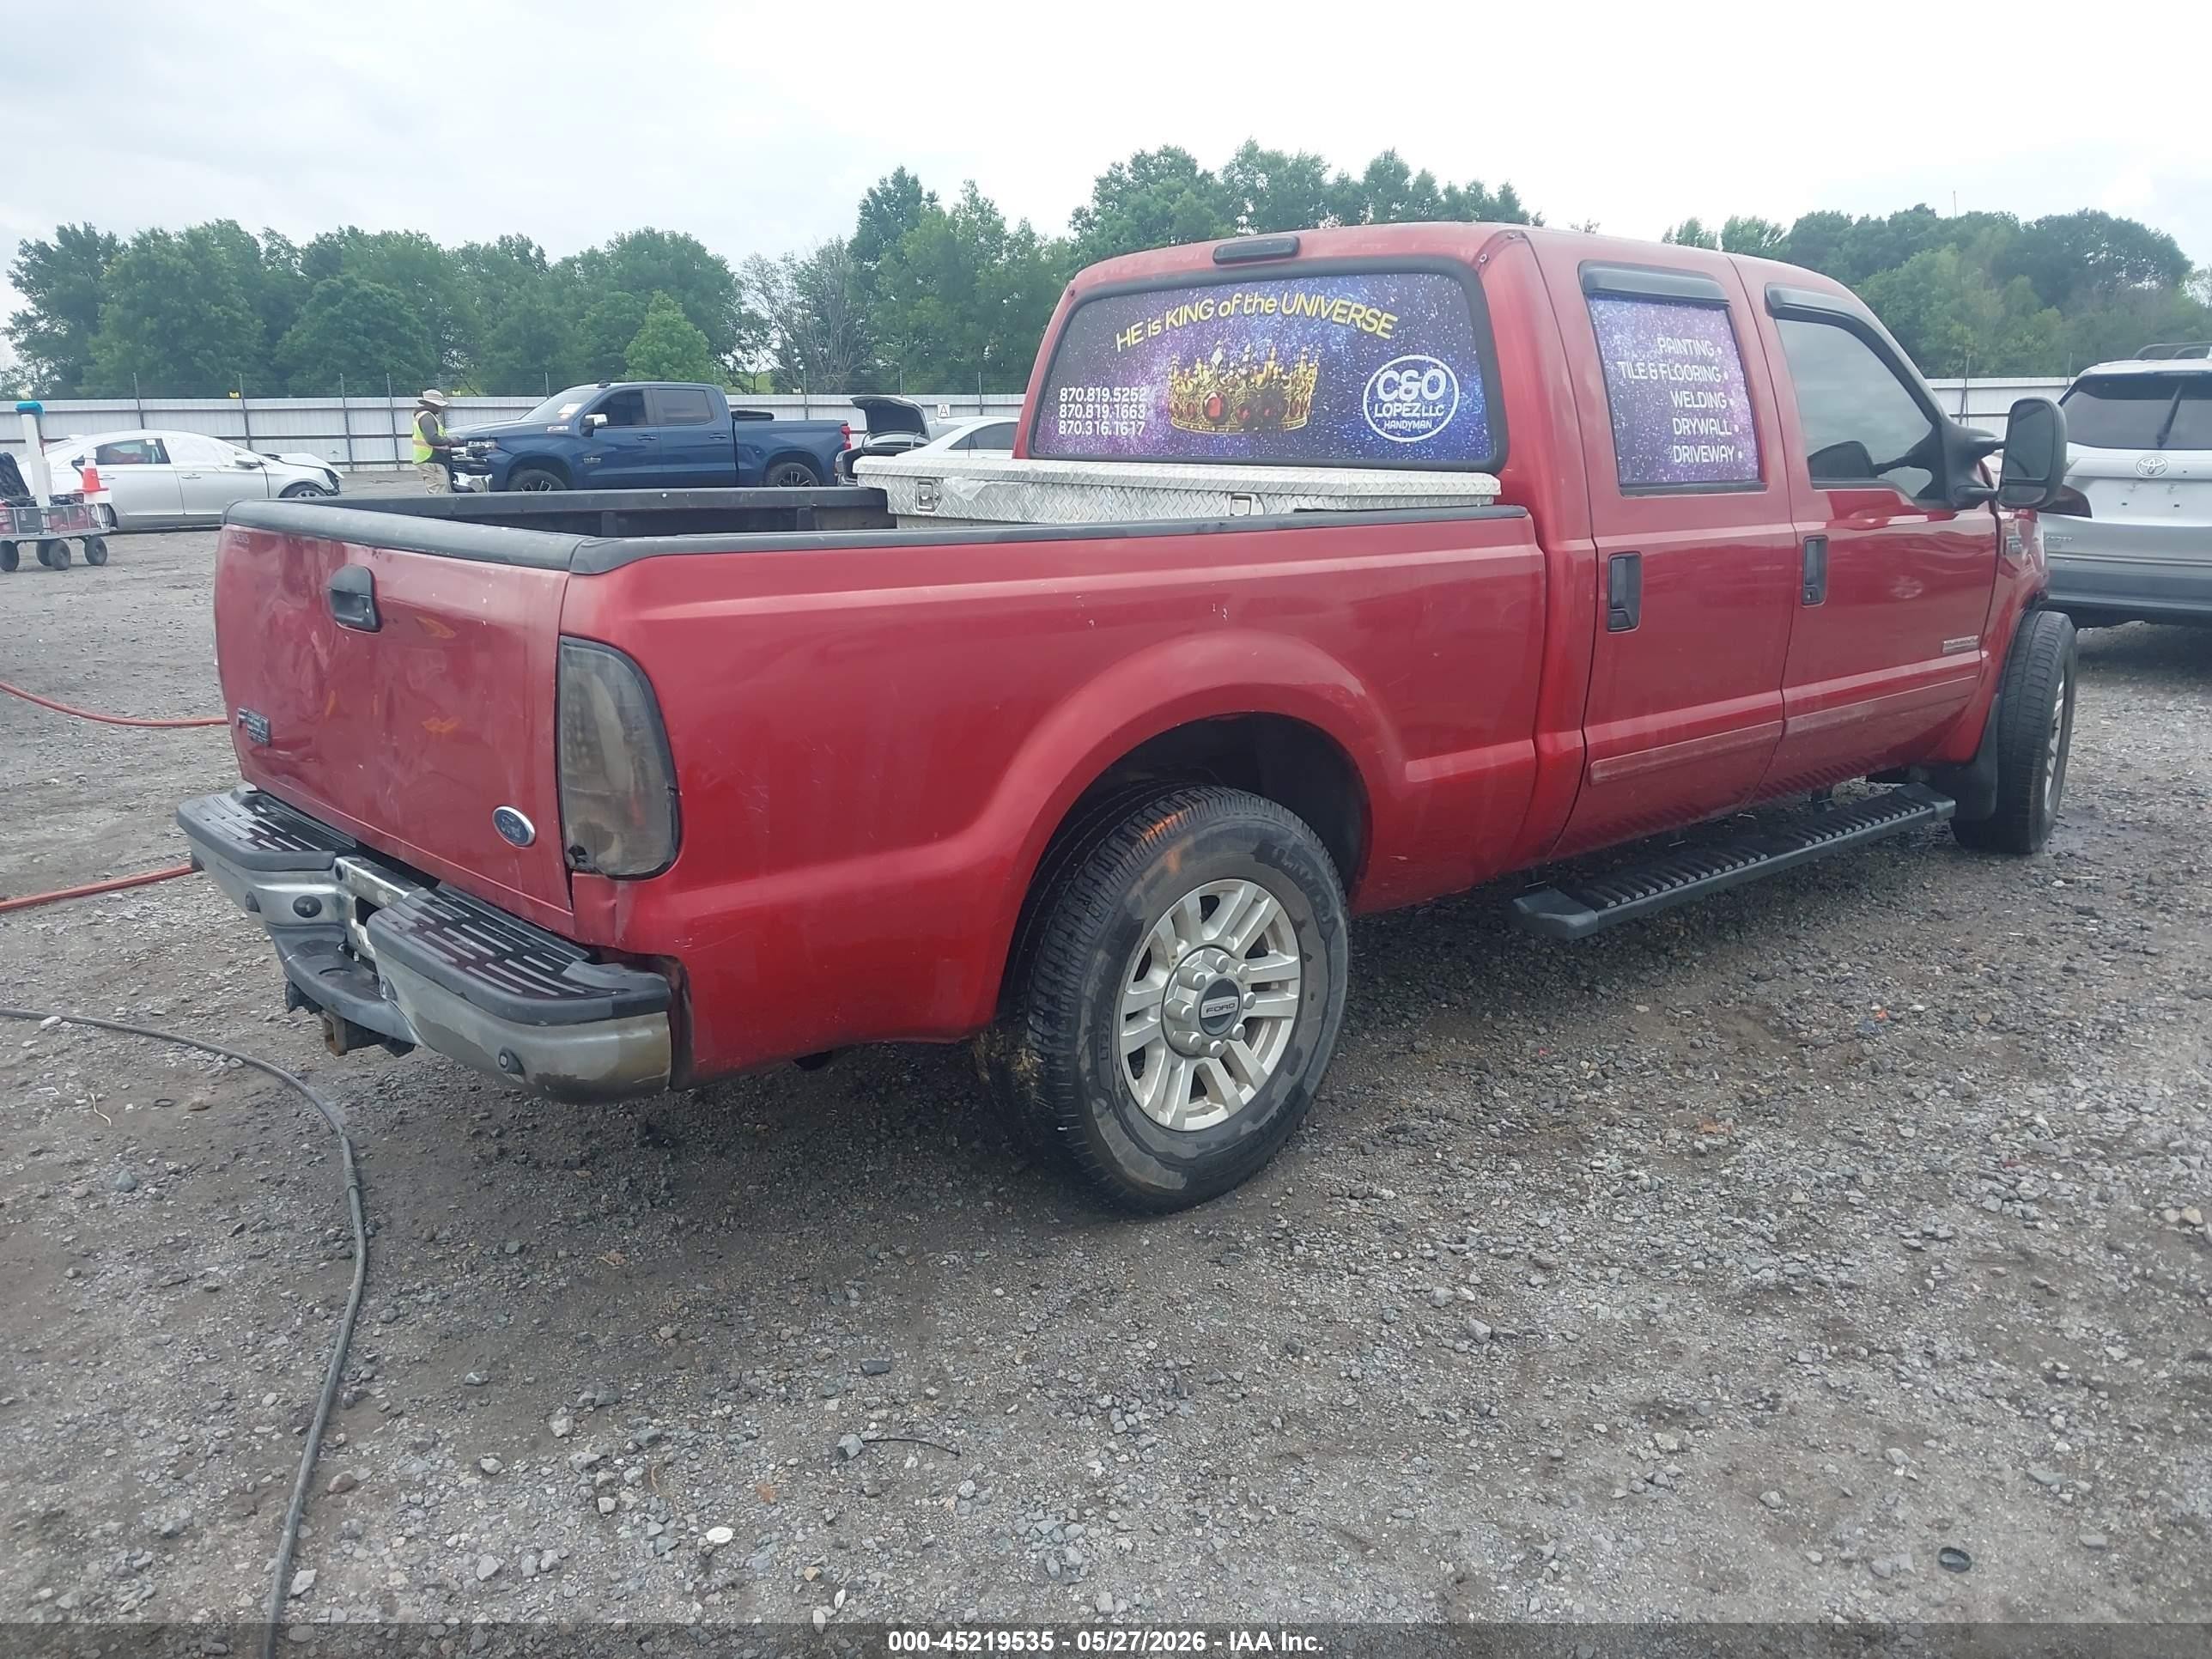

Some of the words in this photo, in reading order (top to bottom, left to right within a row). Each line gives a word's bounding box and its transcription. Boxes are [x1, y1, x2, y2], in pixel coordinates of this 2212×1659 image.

[1115, 322, 1144, 352] HE
[1147, 318, 1162, 338] is
[1165, 299, 1215, 330] KING
[1218, 293, 1242, 317] of
[1243, 294, 1277, 314] the
[1281, 293, 1398, 339] UNIVERSE
[1658, 337, 1714, 356] PAINTING
[1618, 361, 1647, 380] TILE
[1660, 364, 1721, 382] FLOORING
[1377, 368, 1445, 401] C&O
[1060, 387, 1147, 402] 870.819.5252
[1670, 391, 1727, 410] WELDING
[939, 405, 948, 416] A
[1375, 403, 1421, 417] LOPEZ
[1422, 404, 1445, 417] LLC
[1059, 420, 1146, 435] 870.316.1617
[1384, 420, 1432, 431] HANDYMAN
[1673, 417, 1732, 435] DRYWALL
[1674, 446, 1735, 463] DRIVEWAY
[1206, 1003, 1235, 1013] FORD
